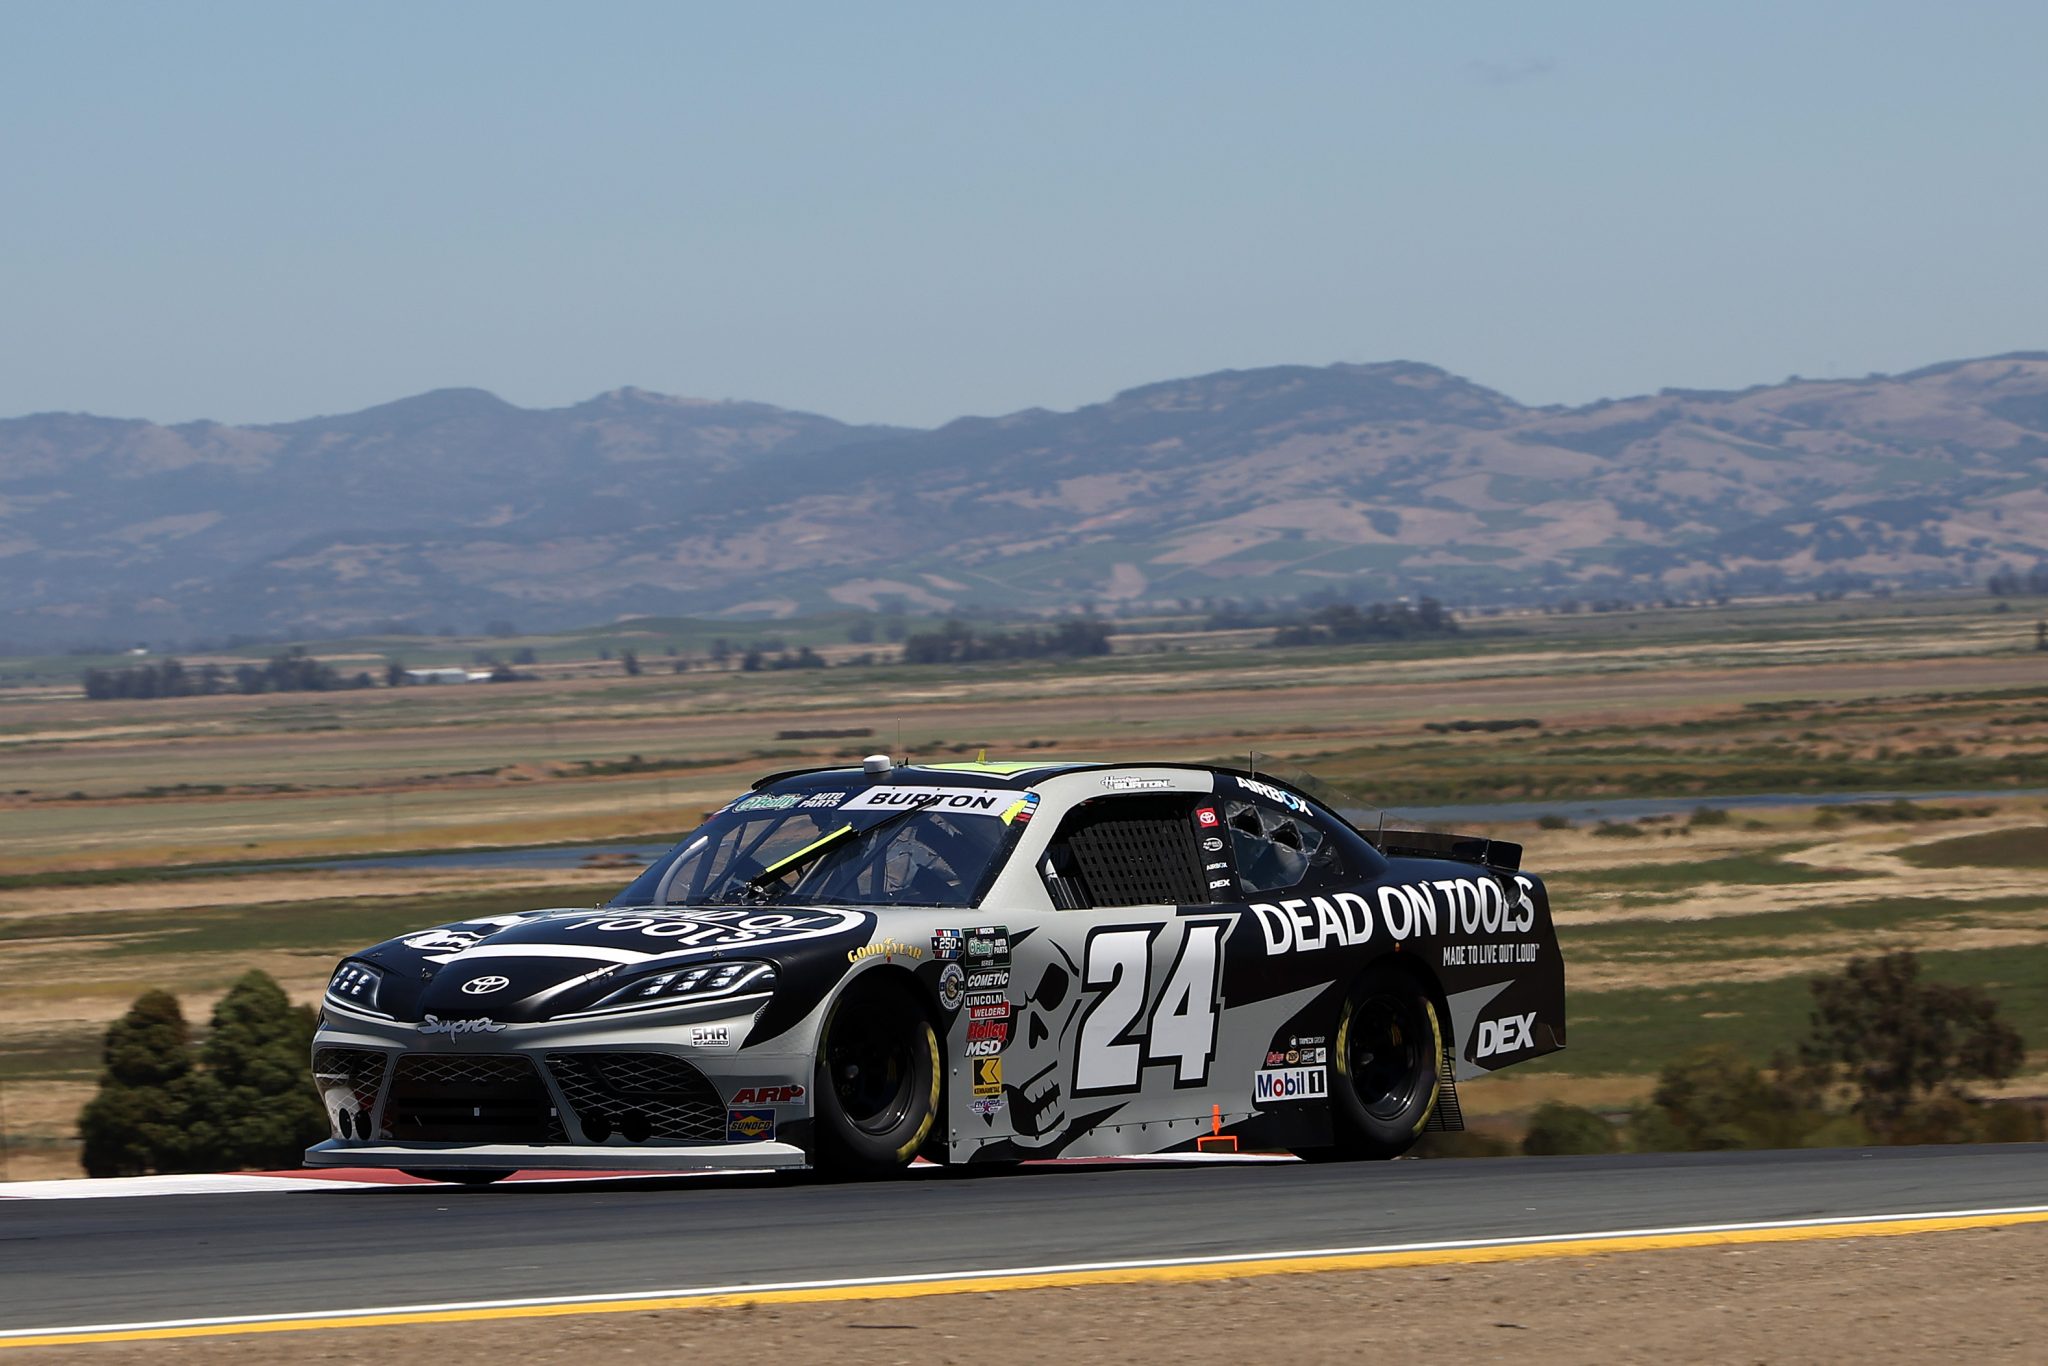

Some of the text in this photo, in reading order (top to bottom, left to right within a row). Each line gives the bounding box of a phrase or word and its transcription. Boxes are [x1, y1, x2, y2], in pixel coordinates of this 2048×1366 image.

[797, 799, 840, 808] PARTS
[809, 792, 846, 800] AUTO
[866, 793, 998, 811] BURTON
[1234, 775, 1314, 817] AIRBOX
[1209, 879, 1231, 889] DEX
[1249, 875, 1536, 956] DEAD ON TOOLS
[938, 938, 957, 949] 250
[993, 945, 1008, 954] PARTS
[1443, 946, 1465, 966] MADE
[1467, 945, 1478, 965] TO
[1479, 945, 1498, 964] LIVE
[1498, 944, 1514, 963] OUT
[967, 971, 1009, 988] COMETIC
[966, 994, 1002, 1006] LINCOLN
[1075, 924, 1218, 1091] 24
[974, 1007, 1006, 1018] WELDERS
[417, 1013, 506, 1044] Supra
[692, 1027, 728, 1040] SHR
[967, 1020, 1008, 1042] Holley
[1476, 1012, 1537, 1058] DEX
[965, 1040, 1001, 1056] MSD
[1256, 1070, 1321, 1100] Mobil 1
[731, 1087, 804, 1105] ARP
[731, 1121, 771, 1131] SUNOCO
